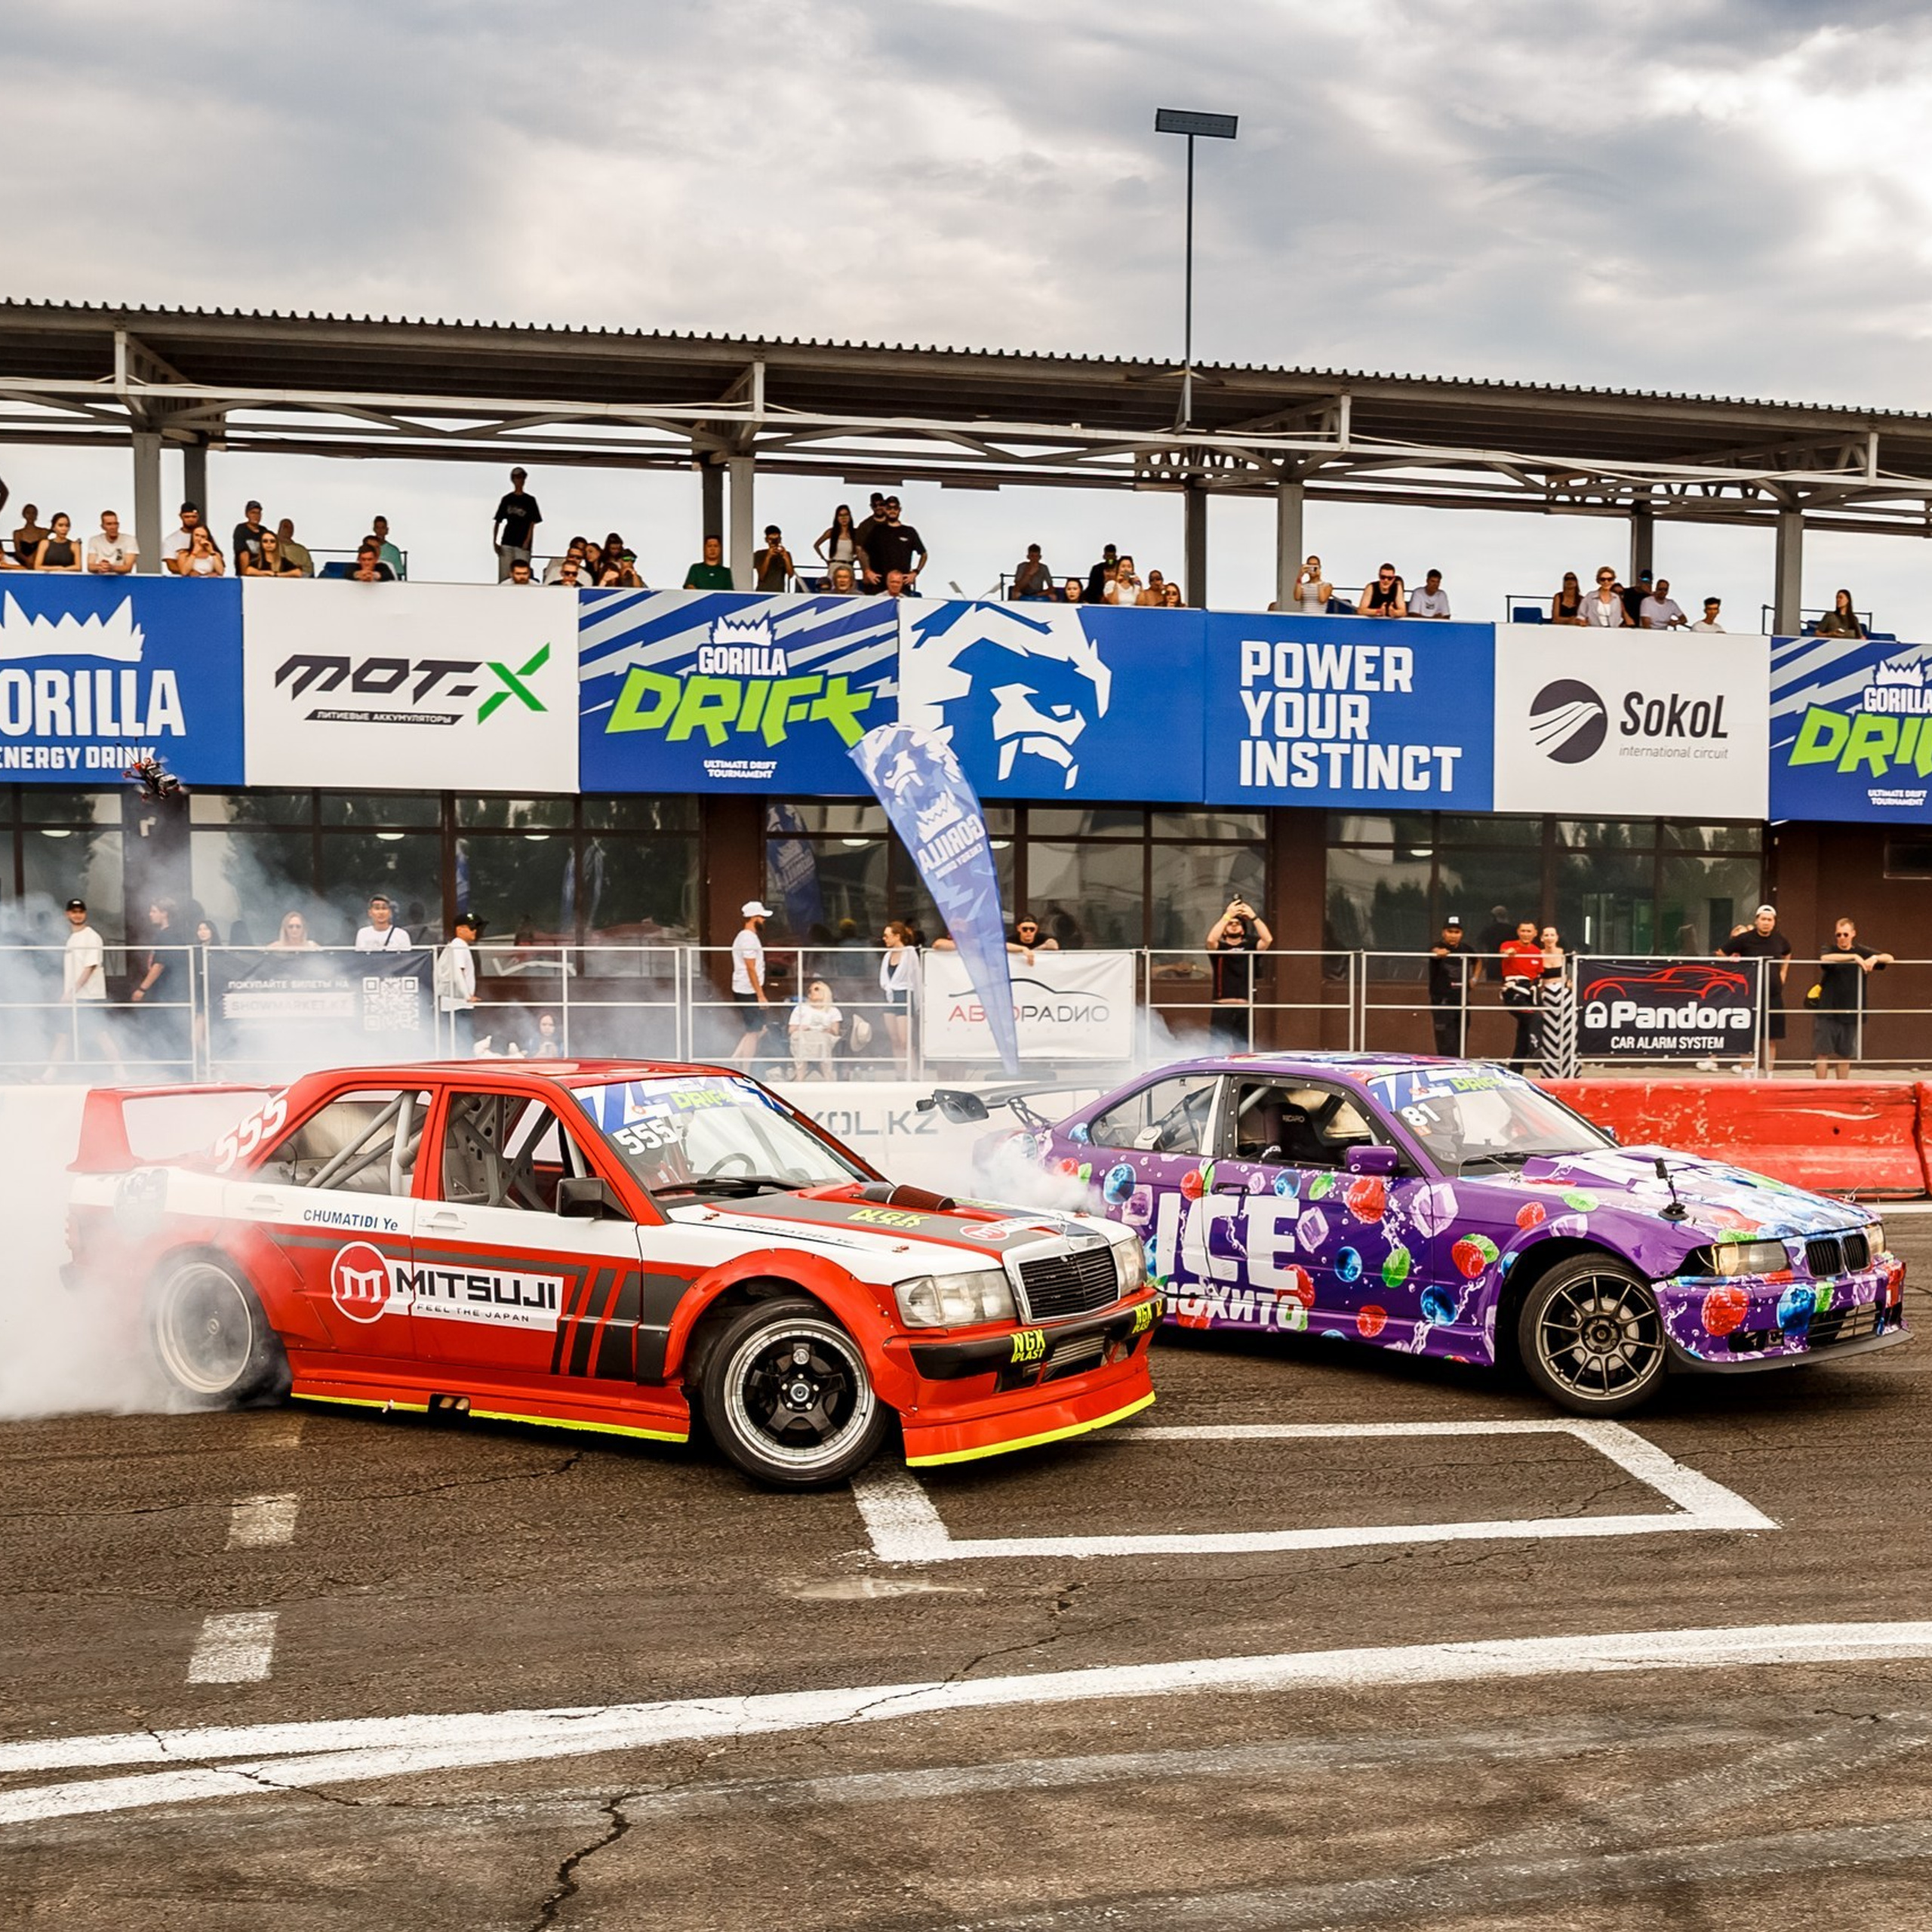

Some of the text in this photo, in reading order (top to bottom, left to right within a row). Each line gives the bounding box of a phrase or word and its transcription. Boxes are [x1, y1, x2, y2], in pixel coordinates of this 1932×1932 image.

[699, 647, 787, 675] GORILLA
[1241, 640, 1414, 693] POWER
[316, 711, 452, 724] ЛИТИЕВЫЕ АККУМУЛЯТОРЫ
[605, 667, 873, 748] DRIFT
[1239, 690, 1370, 740] YOUR
[85, 746, 156, 769] DRINK
[1619, 743, 1729, 759] international circuit
[703, 759, 777, 771] ULTIMATE DRIFT
[706, 769, 774, 779] TOURNAMENT
[1239, 740, 1463, 792] INSTINCT
[228, 979, 349, 989] ПОКУПАЙТЕ БИЛЕТЫ НА
[1611, 1001, 1751, 1029] Pandora
[1611, 1036, 1724, 1049] CAR ALARM SYSTEM
[804, 1111, 939, 1135] OL.KZ
[1401, 1103, 1441, 1127] 81
[214, 1087, 288, 1173] 555
[613, 1118, 678, 1155] 555
[303, 1209, 398, 1231] CHUMATIDI Ye
[1156, 1192, 1300, 1290] ICE
[396, 1267, 556, 1310] MITSUJI
[417, 1303, 530, 1323] FEEL THE JAPAN
[1133, 1302, 1152, 1324] NGK
[1011, 1329, 1046, 1354] NGK
[1011, 1347, 1045, 1364] PLAST
